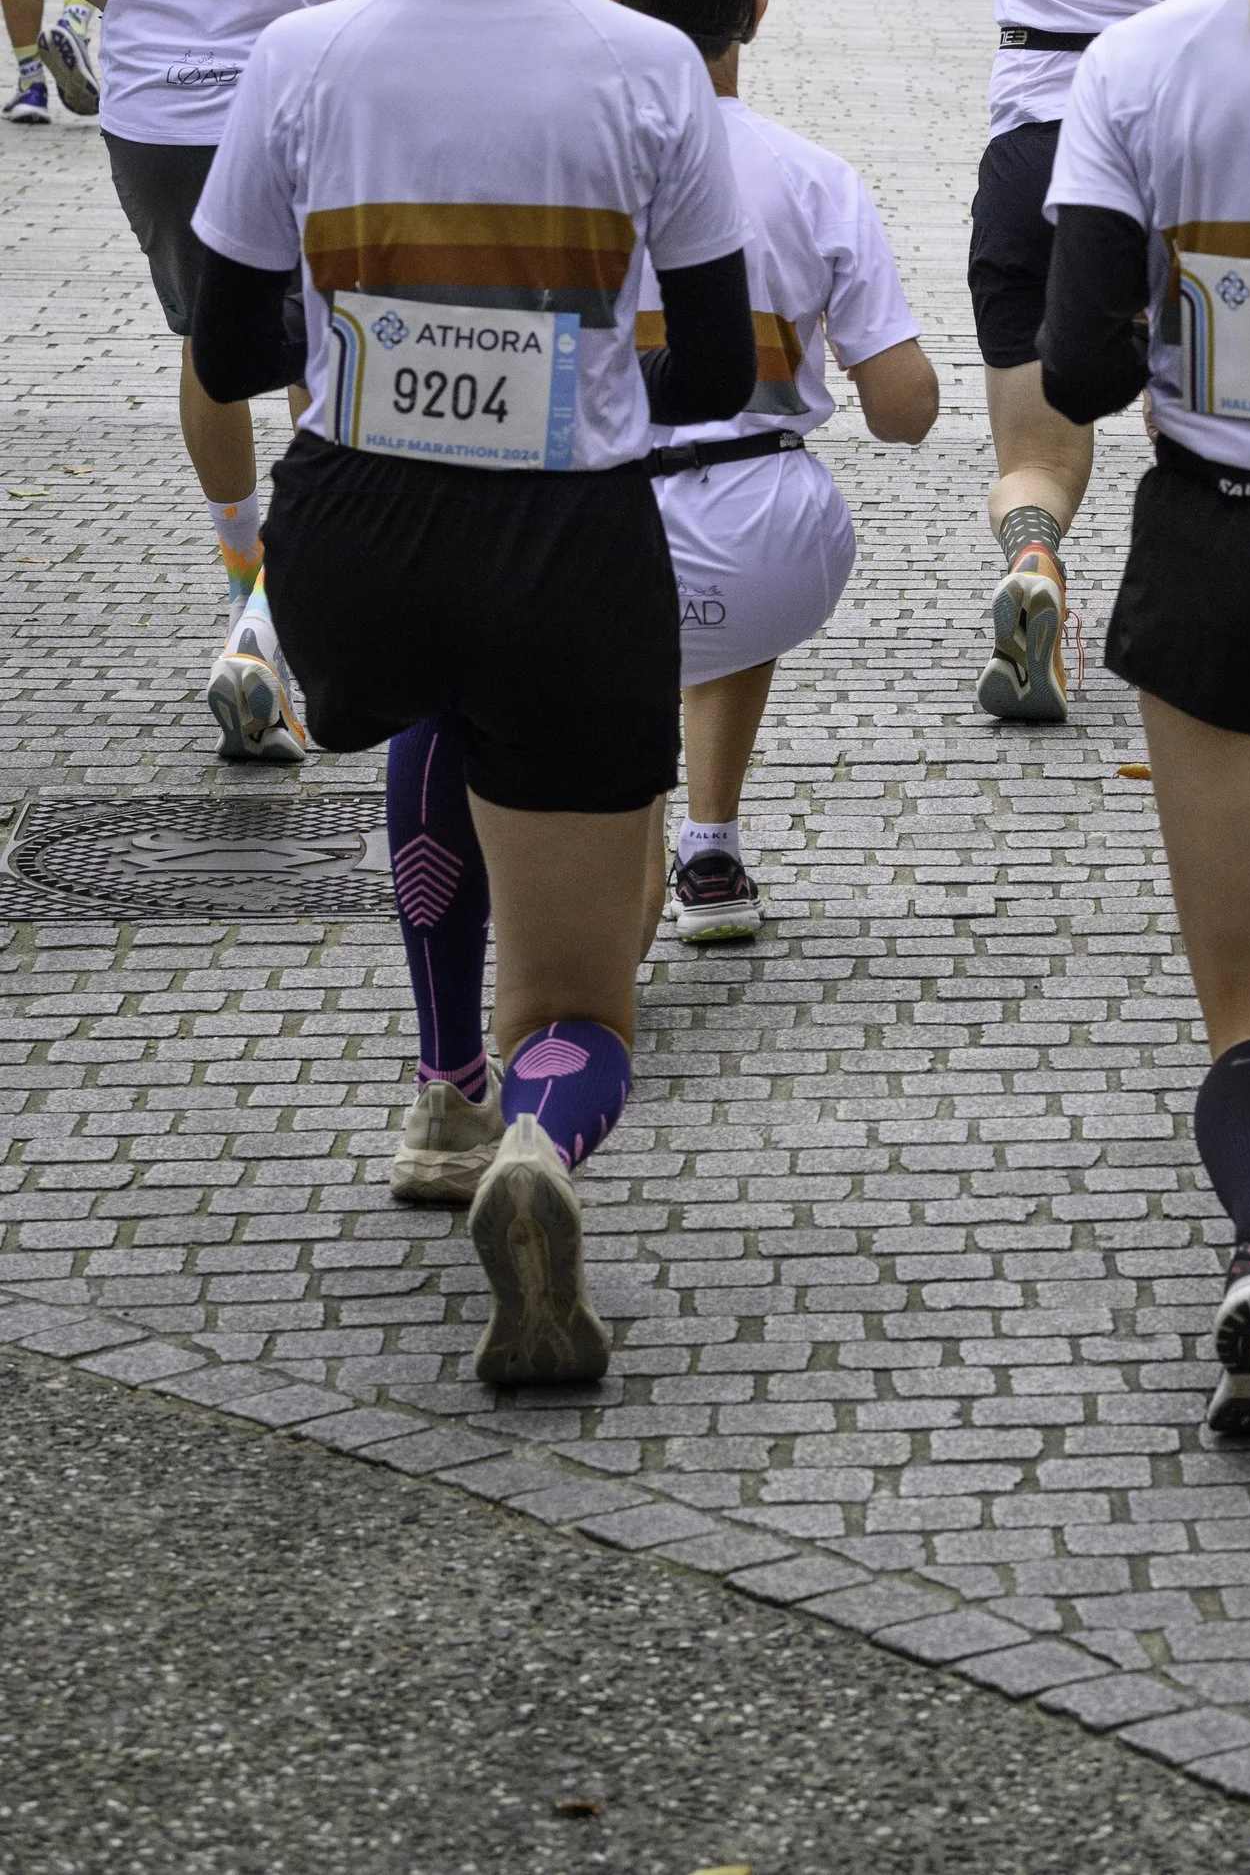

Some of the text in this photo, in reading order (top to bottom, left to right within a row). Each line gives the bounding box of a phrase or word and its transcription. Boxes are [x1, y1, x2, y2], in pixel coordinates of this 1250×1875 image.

[416, 324, 542, 354] ATHORA
[393, 367, 508, 424] 9204
[407, 439, 498, 459] MARATHON
[690, 831, 728, 839] FALKE
